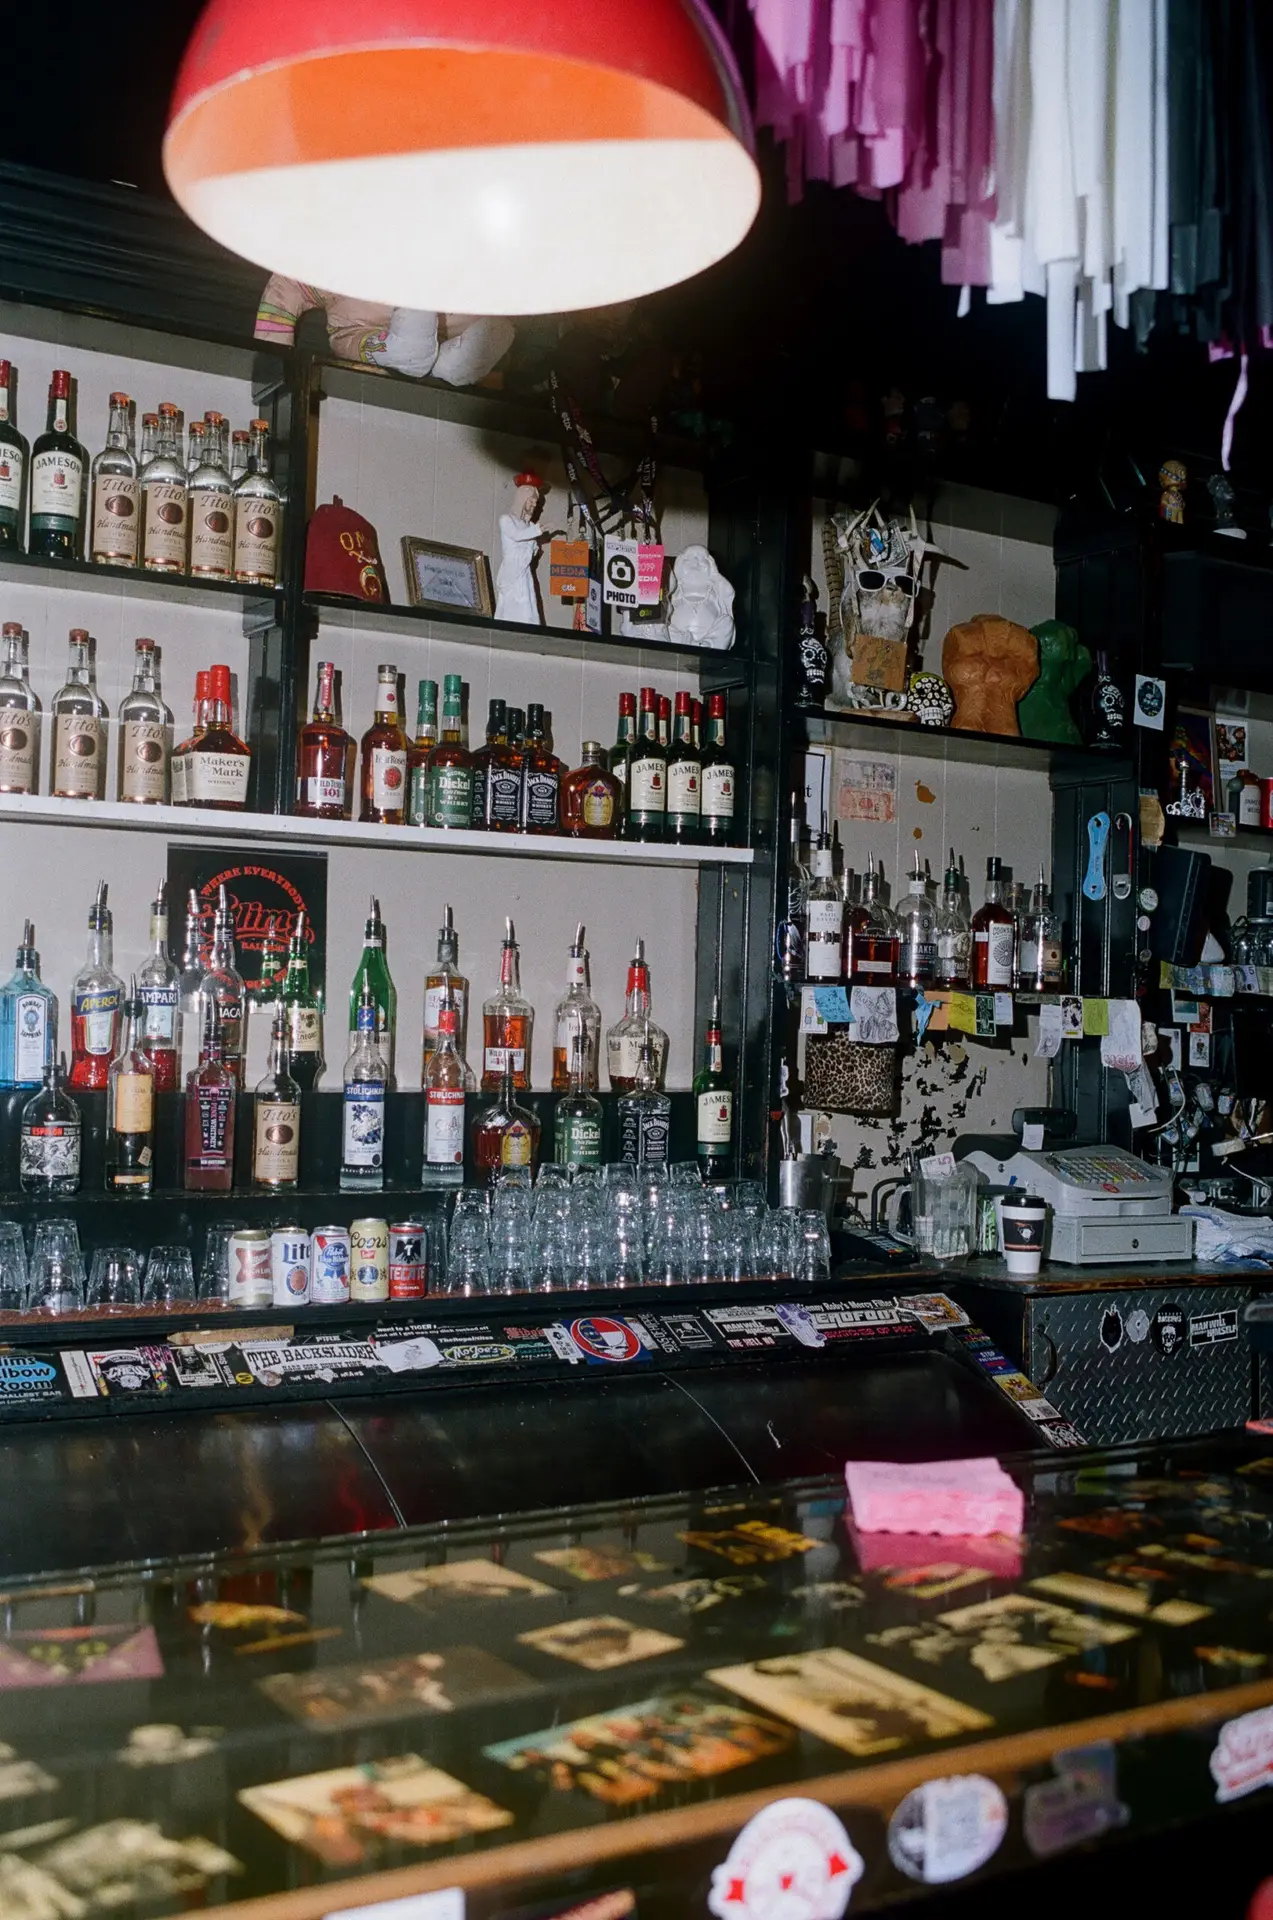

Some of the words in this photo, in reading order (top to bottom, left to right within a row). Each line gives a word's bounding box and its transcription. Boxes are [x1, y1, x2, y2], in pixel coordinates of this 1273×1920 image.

[36, 457, 81, 474] JAMESON
[102, 478, 137, 494] Tito's
[551, 565, 587, 577] MEDIA
[638, 575, 659, 583] EDIA
[606, 590, 637, 605] PHOTO
[64, 718, 99, 733] Tito's
[132, 724, 166, 739] Tito's
[200, 756, 245, 769] Maker's
[636, 762, 664, 774] JAMES
[212, 767, 243, 777] Mark
[673, 765, 700, 777] JAMES
[707, 769, 734, 780] JAMES
[439, 777, 470, 789] Dickel
[491, 773, 503, 784] JACK
[528, 777, 540, 787] JACK
[323, 788, 340, 798] 101
[200, 865, 241, 896] WHERE
[244, 865, 307, 912] EVERYBODY
[704, 1095, 731, 1106] JAMES
[263, 1109, 297, 1122] Tito's
[350, 1231, 387, 1249] Coors
[282, 1242, 310, 1264] Lite
[326, 1246, 344, 1256] Pabst
[403, 1245, 413, 1256] T
[390, 1266, 425, 1280] TECATE
[723, 1323, 743, 1333] MAN
[1192, 1322, 1209, 1331] MAN
[1209, 1318, 1226, 1329] WILL
[727, 1339, 743, 1347] THE
[743, 1337, 762, 1346] HELL
[0, 1356, 35, 1367] ims
[247, 1350, 281, 1371] THE
[281, 1344, 378, 1363] BACKSLIDER
[0, 1368, 50, 1379] lbow
[0, 1391, 40, 1399] MALLEST
